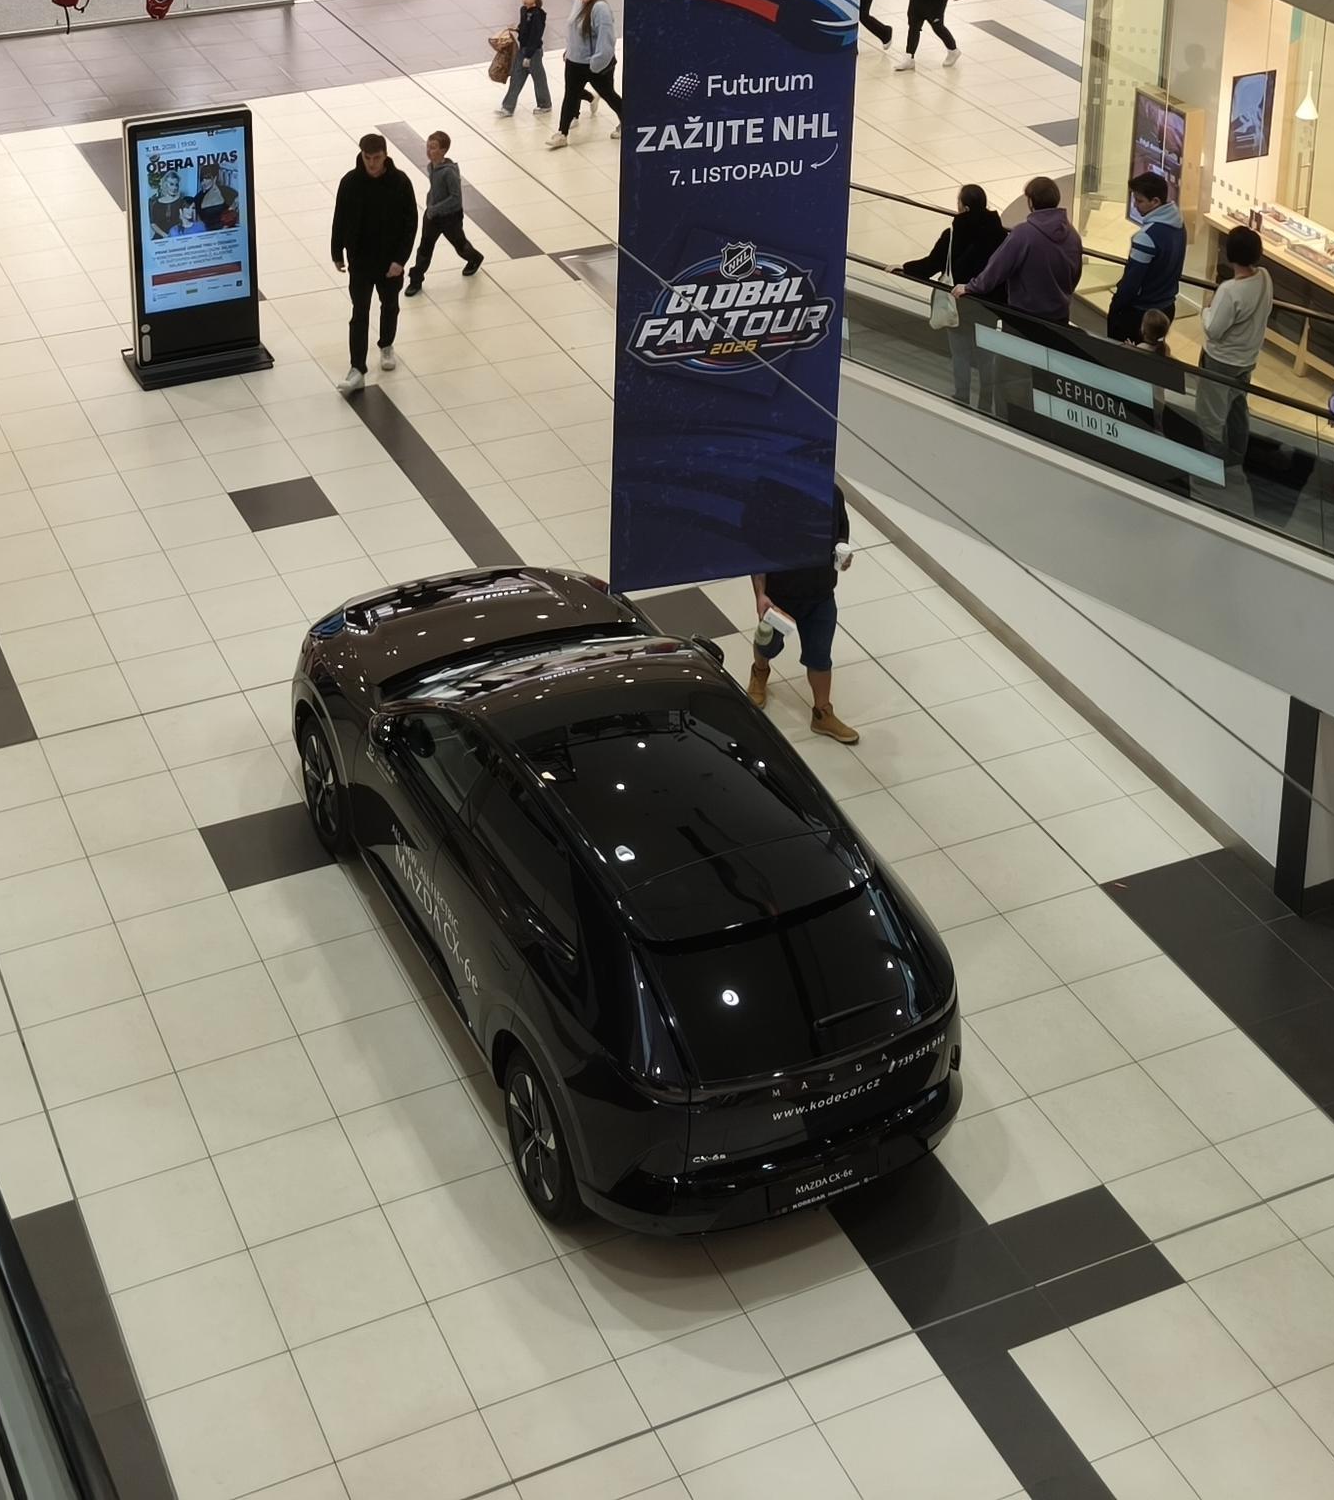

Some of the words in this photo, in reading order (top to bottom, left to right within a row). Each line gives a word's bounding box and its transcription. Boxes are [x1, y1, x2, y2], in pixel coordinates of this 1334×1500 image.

[707, 73, 813, 97] Futurum
[635, 116, 764, 153] ZAŽIJTE
[772, 113, 838, 142] NHL
[146, 156, 194, 173] OPERA
[196, 150, 238, 167] DIVAS
[669, 169, 686, 186] 7.
[691, 159, 803, 185] LISTOPADU
[727, 250, 750, 273] NHL
[666, 276, 804, 315] GLOBAL
[710, 340, 758, 355] 2026
[1056, 378, 1127, 420] SEPHORA
[1067, 408, 1078, 422] 01
[1087, 416, 1098, 430] 10
[1106, 422, 1118, 438] 26
[395, 845, 442, 933] MAZDA
[443, 921, 479, 997] CX-6e
[897, 1052, 915, 1069] 739
[915, 1045, 930, 1061] 521
[772, 1052, 888, 1098] MAZDA
[772, 1076, 881, 1122] www.kodecar.cz
[795, 1177, 828, 1195] MAZDA
[828, 1168, 854, 1184] CX-6e
